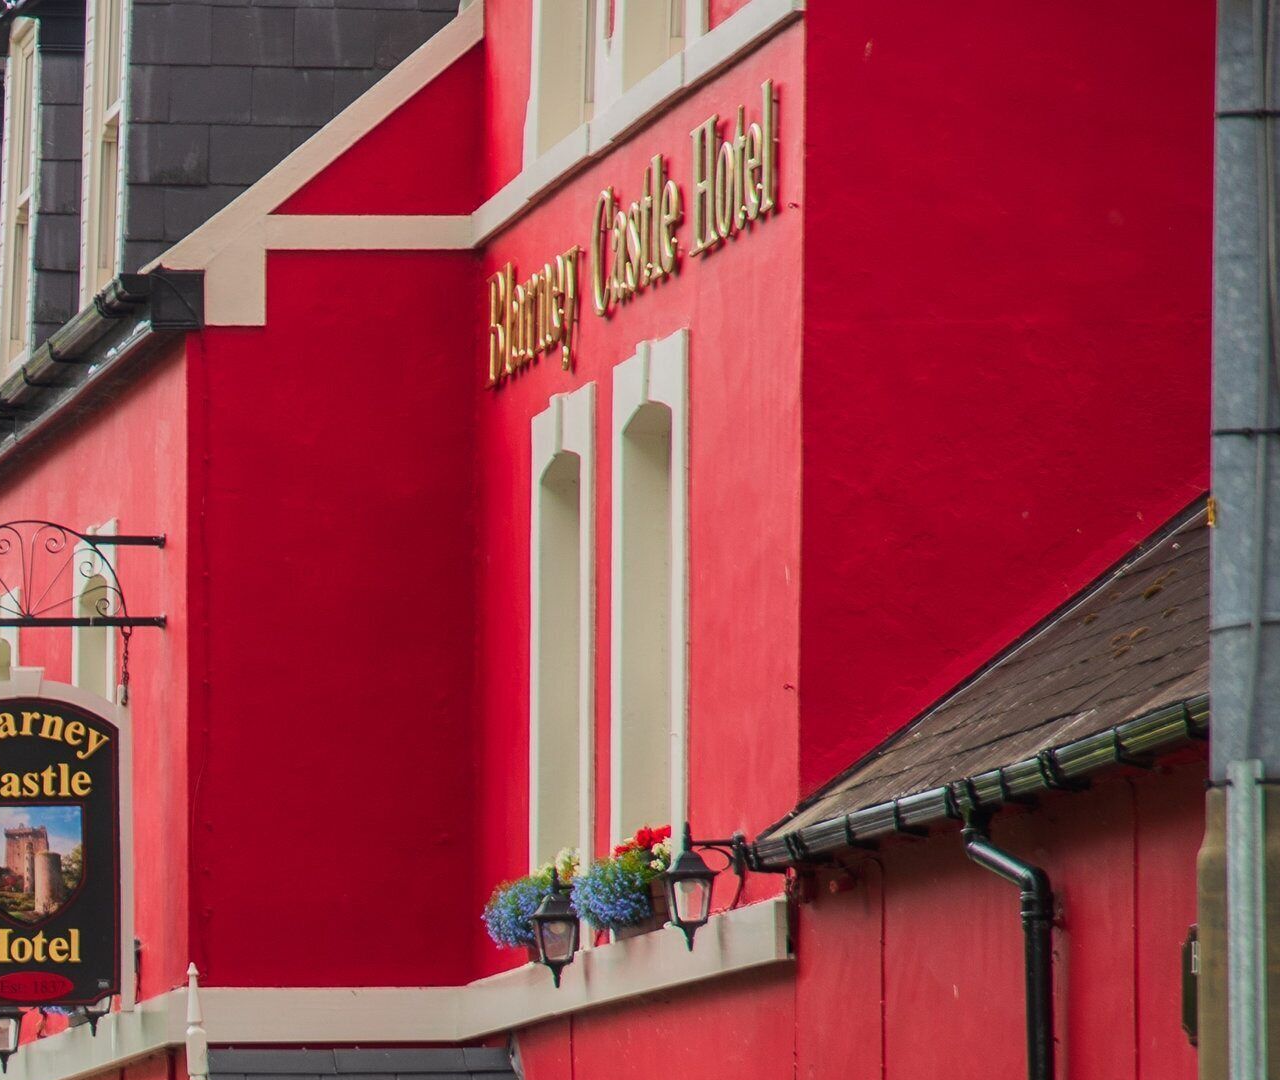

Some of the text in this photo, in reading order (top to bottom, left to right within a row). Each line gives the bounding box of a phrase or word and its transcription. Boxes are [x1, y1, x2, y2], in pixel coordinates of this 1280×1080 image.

[486, 79, 776, 388] Blarney Castle Hotel
